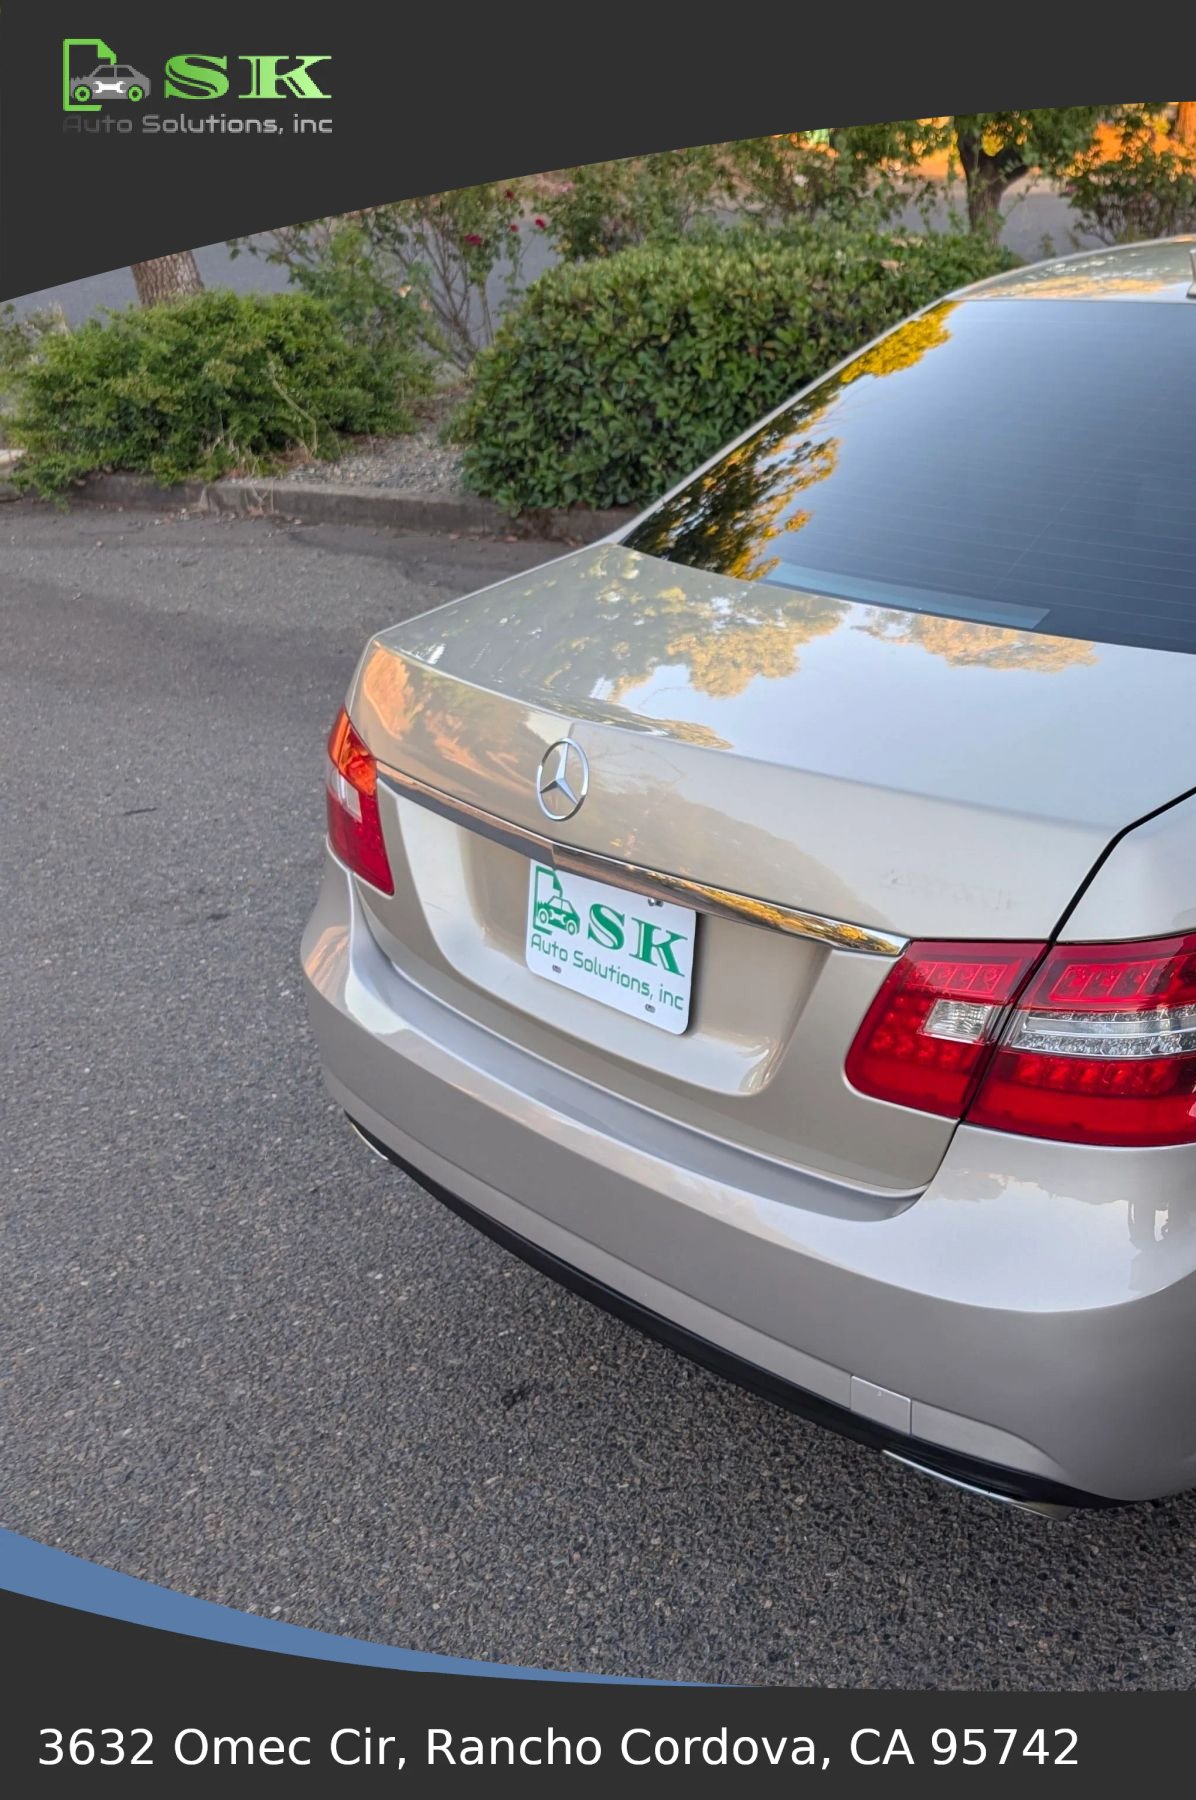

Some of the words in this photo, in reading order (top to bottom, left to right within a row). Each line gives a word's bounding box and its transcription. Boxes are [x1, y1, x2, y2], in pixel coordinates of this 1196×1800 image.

[530, 933, 569, 962] Auto
[573, 950, 654, 1000] Solutions,
[658, 984, 685, 1011] inc
[587, 903, 688, 977] SK
